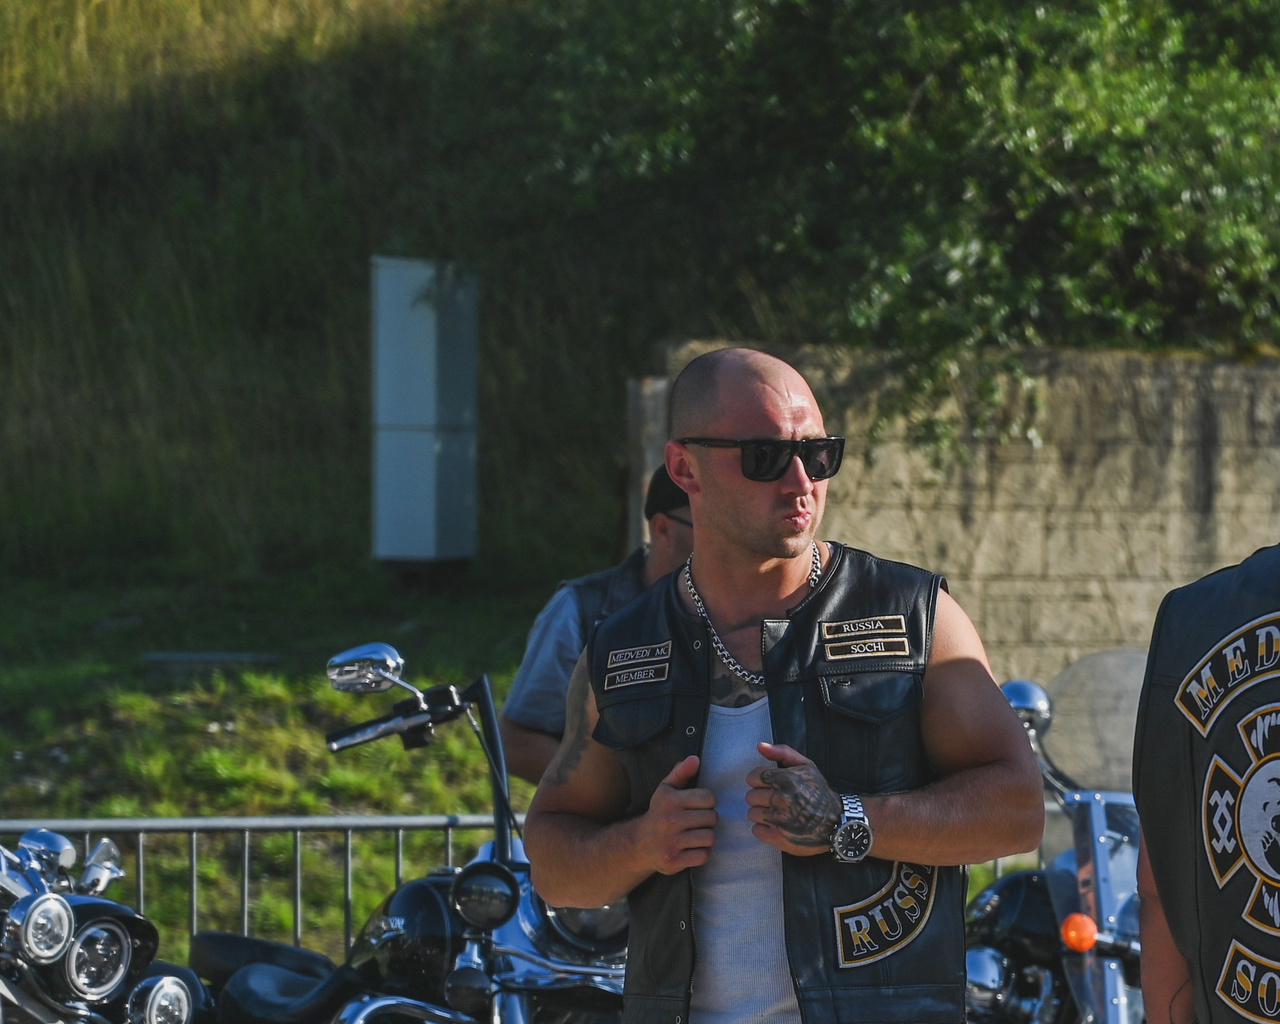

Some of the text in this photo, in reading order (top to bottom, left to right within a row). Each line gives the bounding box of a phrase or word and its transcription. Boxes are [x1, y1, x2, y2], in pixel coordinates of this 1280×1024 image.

[843, 620, 885, 633] RUSSIA
[611, 646, 669, 664] MEDVEDI MC
[850, 642, 885, 654] SOCHI
[615, 669, 655, 684] MEMBER
[844, 864, 932, 956] RUSS
